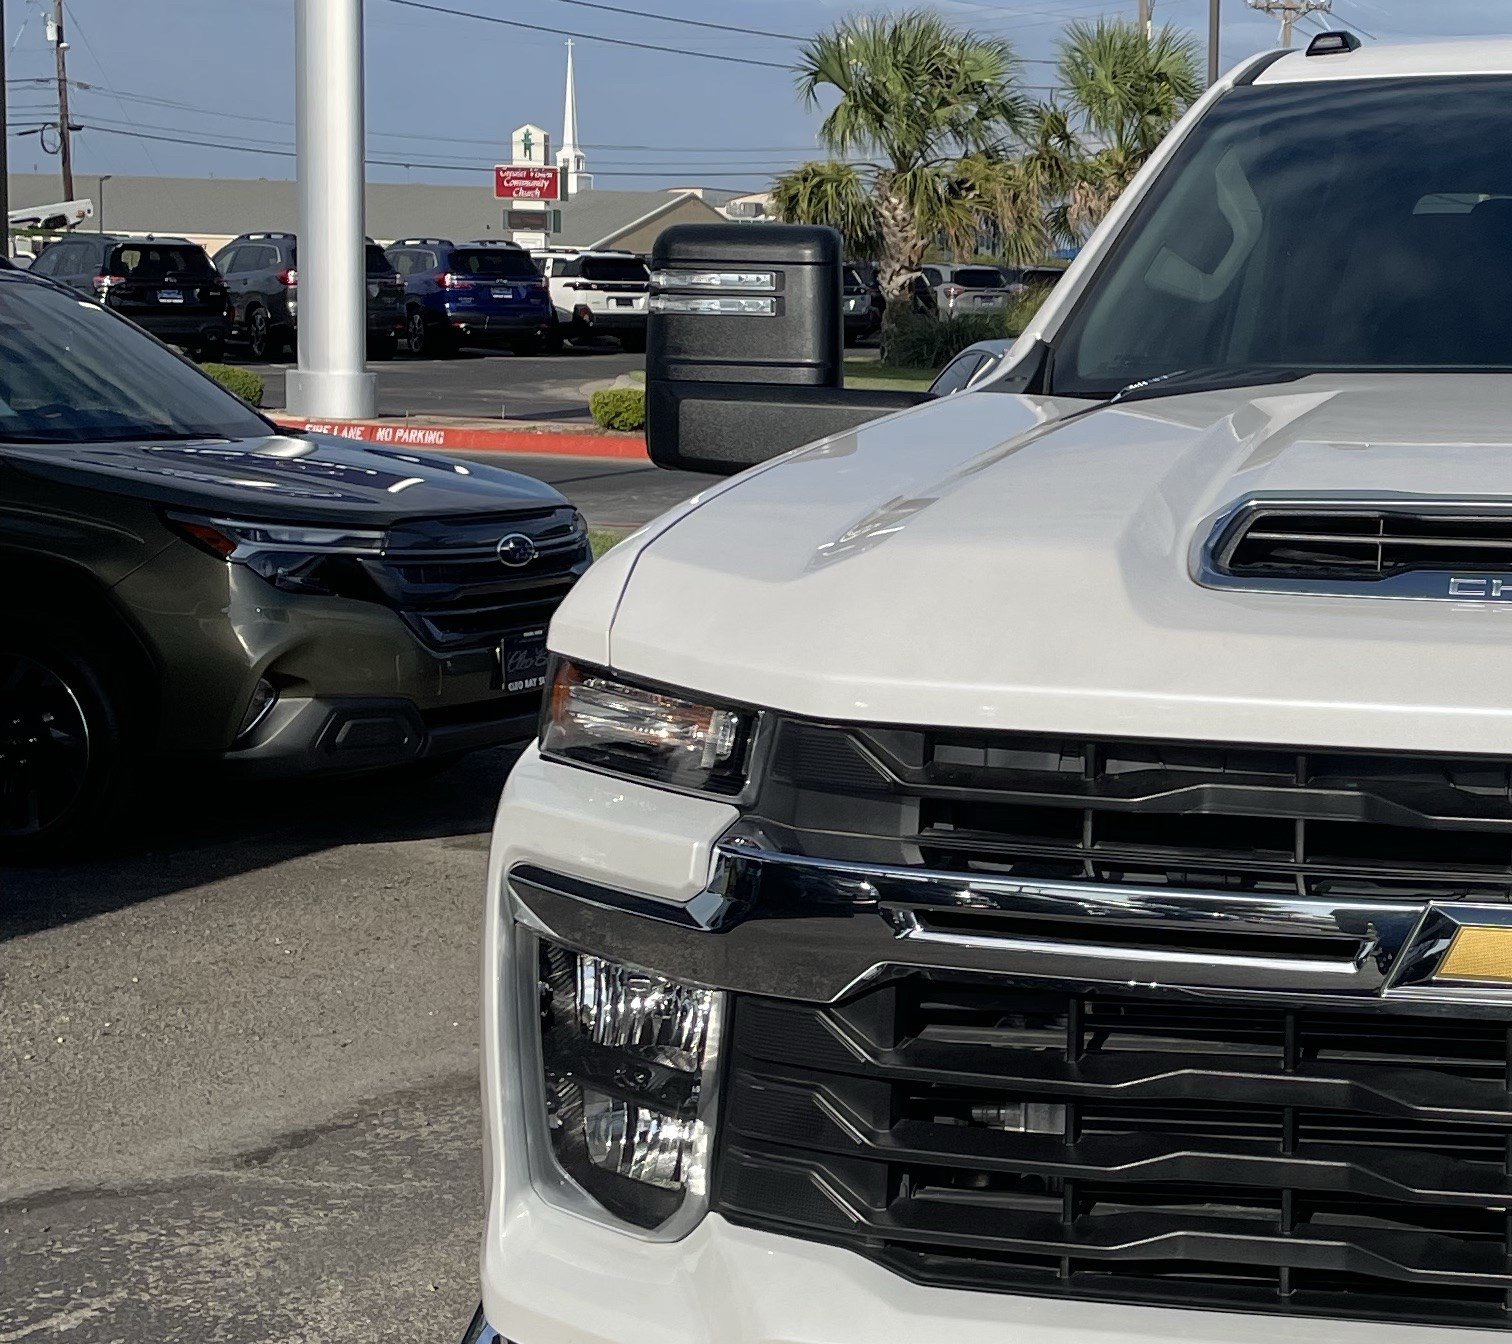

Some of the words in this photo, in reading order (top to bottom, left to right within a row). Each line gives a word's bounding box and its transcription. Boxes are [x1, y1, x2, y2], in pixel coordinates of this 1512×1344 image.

[503, 178, 550, 191] Community
[512, 187, 541, 198] Church
[376, 427, 393, 441] NO
[394, 428, 445, 445] PARKING
